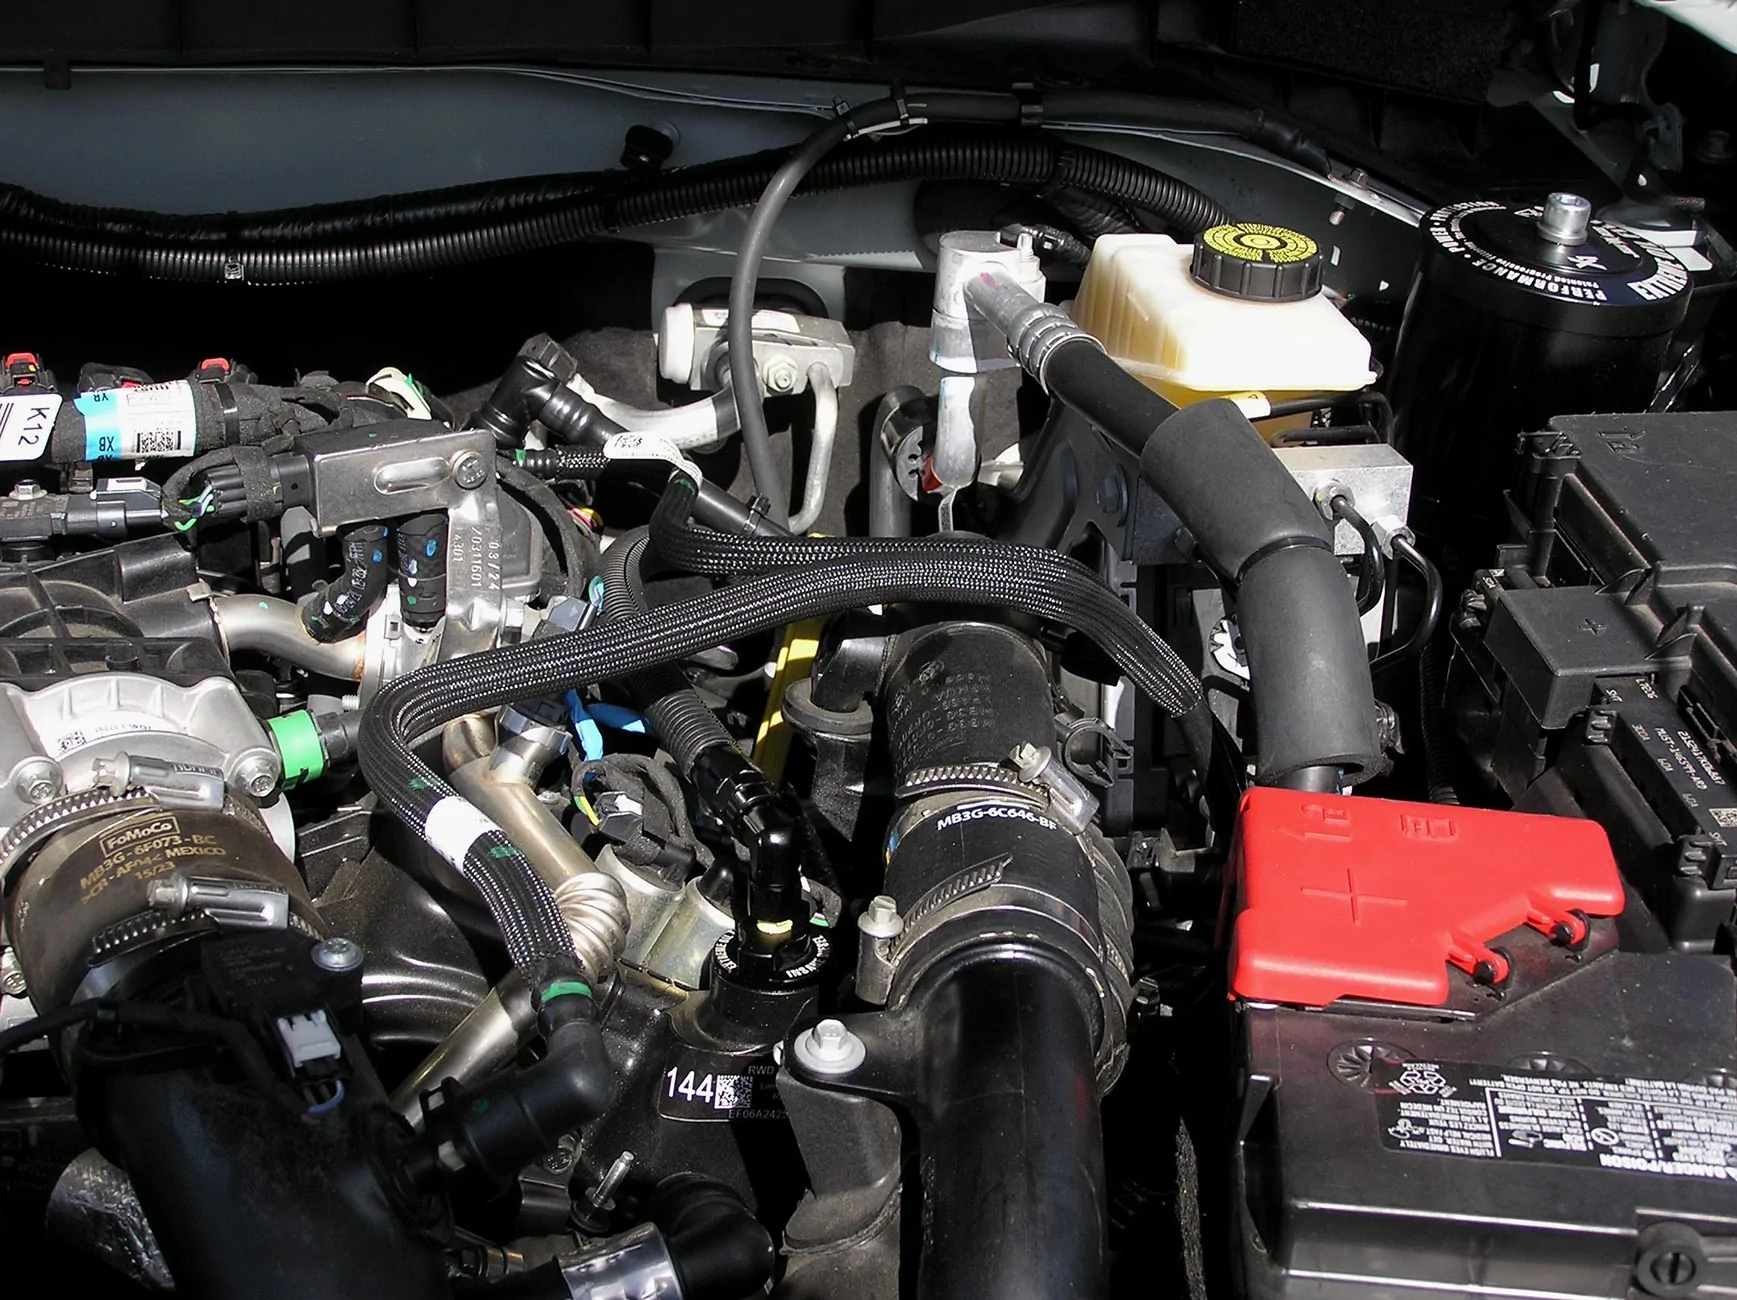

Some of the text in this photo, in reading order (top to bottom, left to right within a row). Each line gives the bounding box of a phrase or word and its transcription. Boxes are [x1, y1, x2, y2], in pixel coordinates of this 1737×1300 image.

[1430, 227, 1465, 253] POWER
[1472, 258, 1607, 301] PERFORMANCE
[18, 407, 50, 445] K12
[99, 437, 114, 451] XB
[488, 541, 499, 590] 03/24
[937, 807, 1056, 830] MB3G-6C646-BF
[107, 821, 173, 849] FoMoCo
[80, 835, 217, 889] MB3G-6F073-BC
[165, 846, 227, 858] MEXICO
[748, 1065, 774, 1075] RWD
[667, 1067, 714, 1103] 144
